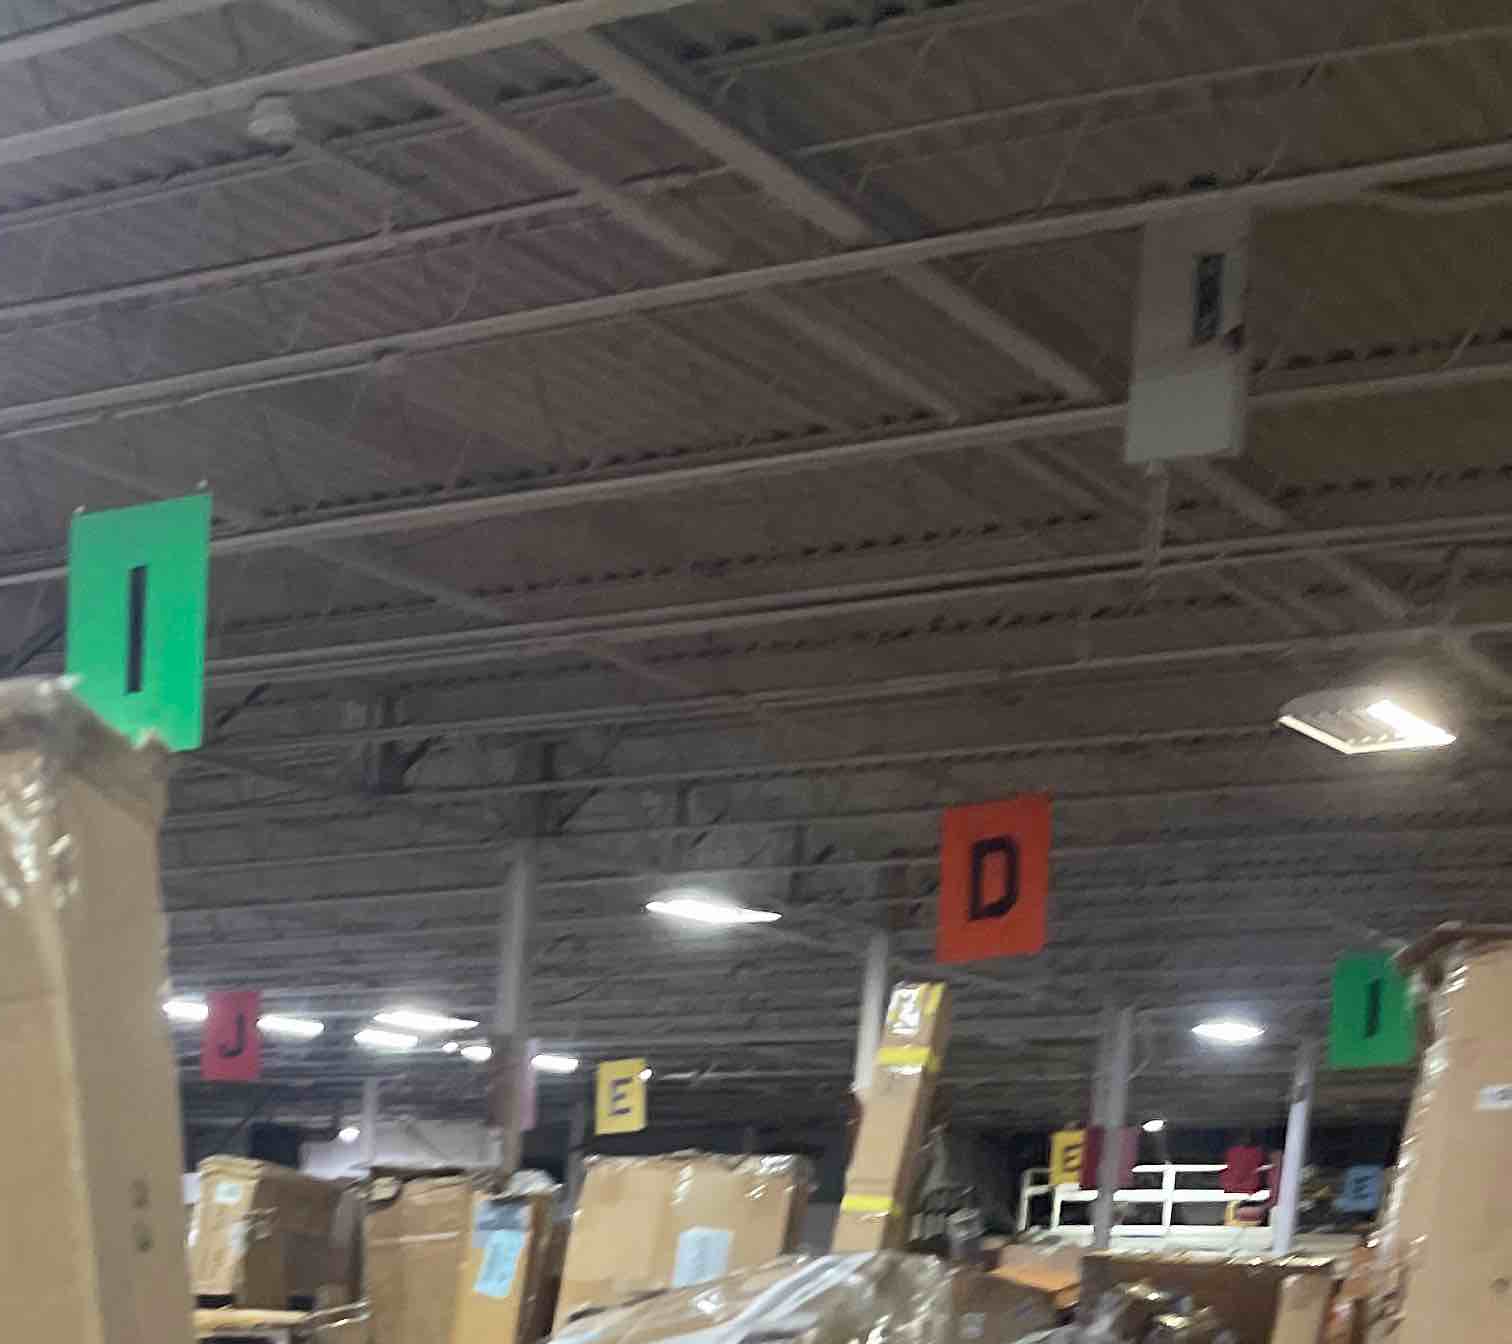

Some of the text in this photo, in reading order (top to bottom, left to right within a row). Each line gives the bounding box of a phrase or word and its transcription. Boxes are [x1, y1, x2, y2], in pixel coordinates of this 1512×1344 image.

[966, 835, 1021, 922] D
[218, 1011, 247, 1058] J
[609, 1076, 635, 1116] E
